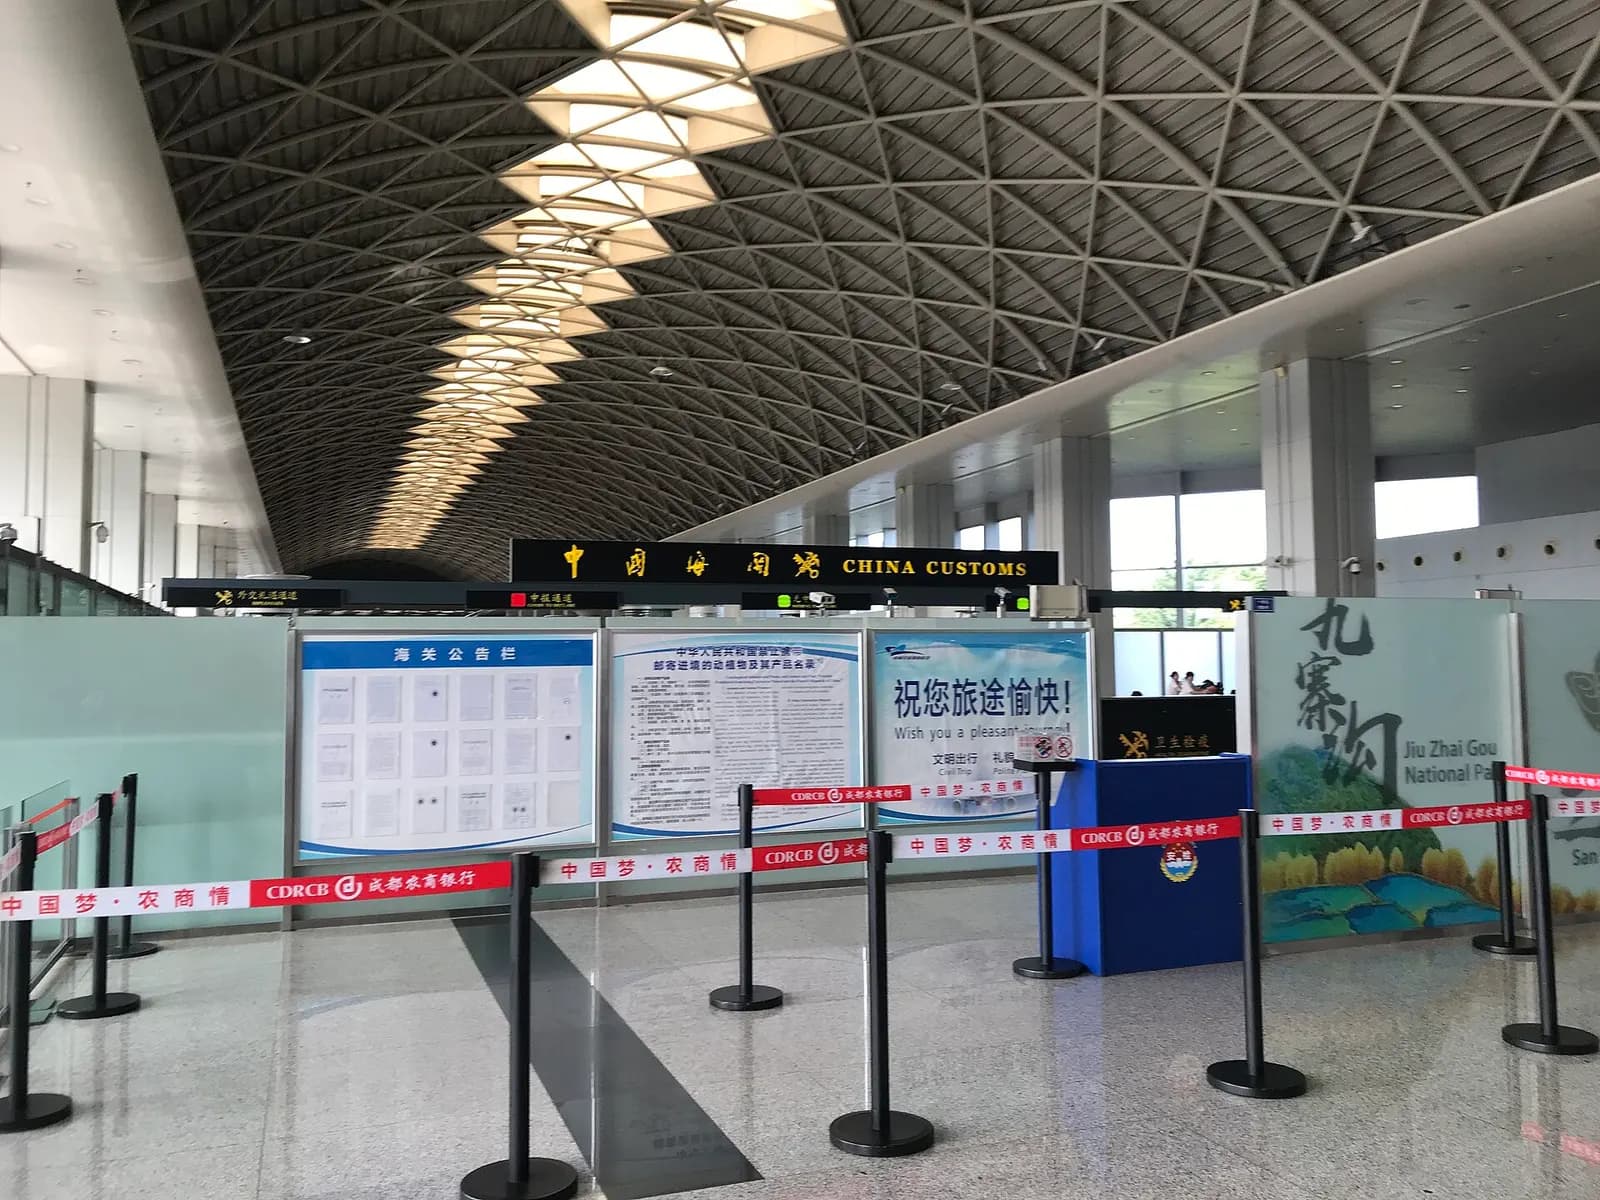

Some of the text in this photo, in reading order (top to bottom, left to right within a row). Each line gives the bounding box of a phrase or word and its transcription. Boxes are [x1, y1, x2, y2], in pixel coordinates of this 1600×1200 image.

[843, 559, 1027, 576] CHINA CUSTOMS
[393, 647, 516, 662] 海关公告栏
[894, 677, 1071, 718] 祝您旅途愉快!
[1295, 598, 1402, 806] 九寨沟
[895, 726, 924, 740] Wish
[930, 728, 951, 742] you
[957, 729, 965, 739] a
[1404, 739, 1497, 759] Jiu Zhai Gou
[932, 752, 978, 765] 文明出行
[1405, 763, 1494, 784] National Pa
[791, 792, 826, 801] CDRCB
[845, 789, 905, 800] 成都农商银行
[1081, 831, 1123, 844] CDRCB
[1148, 823, 1219, 840] 成都农商银行
[764, 849, 814, 864] CDRCB
[1, 870, 476, 917] 中国梦·农商情 CDRCB 成都农商银行
